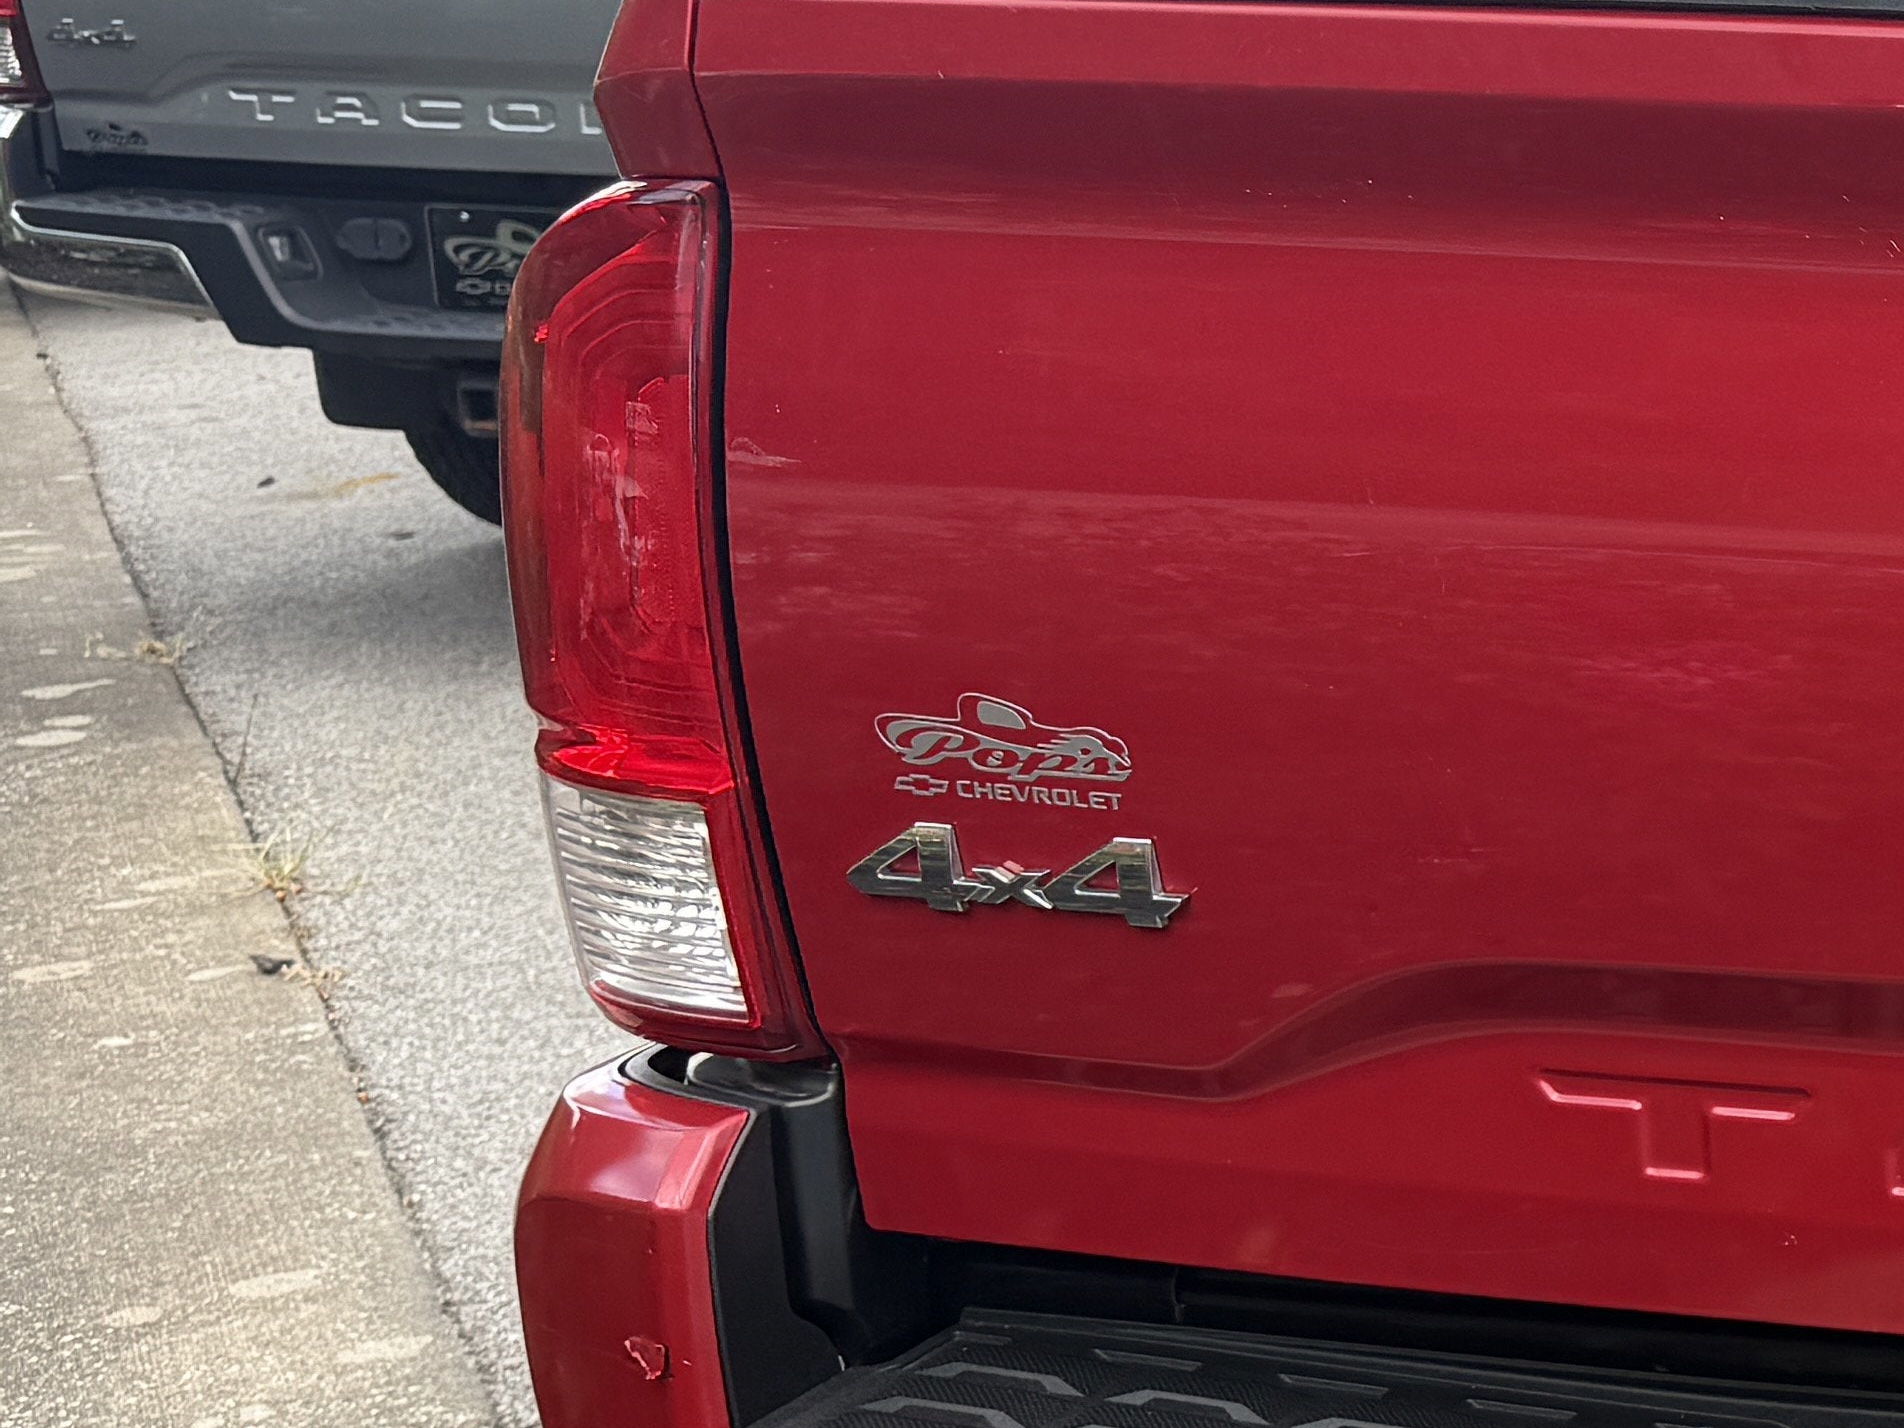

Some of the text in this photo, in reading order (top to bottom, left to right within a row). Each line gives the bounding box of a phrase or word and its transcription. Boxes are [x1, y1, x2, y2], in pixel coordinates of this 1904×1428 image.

[227, 86, 604, 138] TACO
[956, 779, 1122, 811] CHEVROLET
[846, 821, 1194, 929] 4x4
